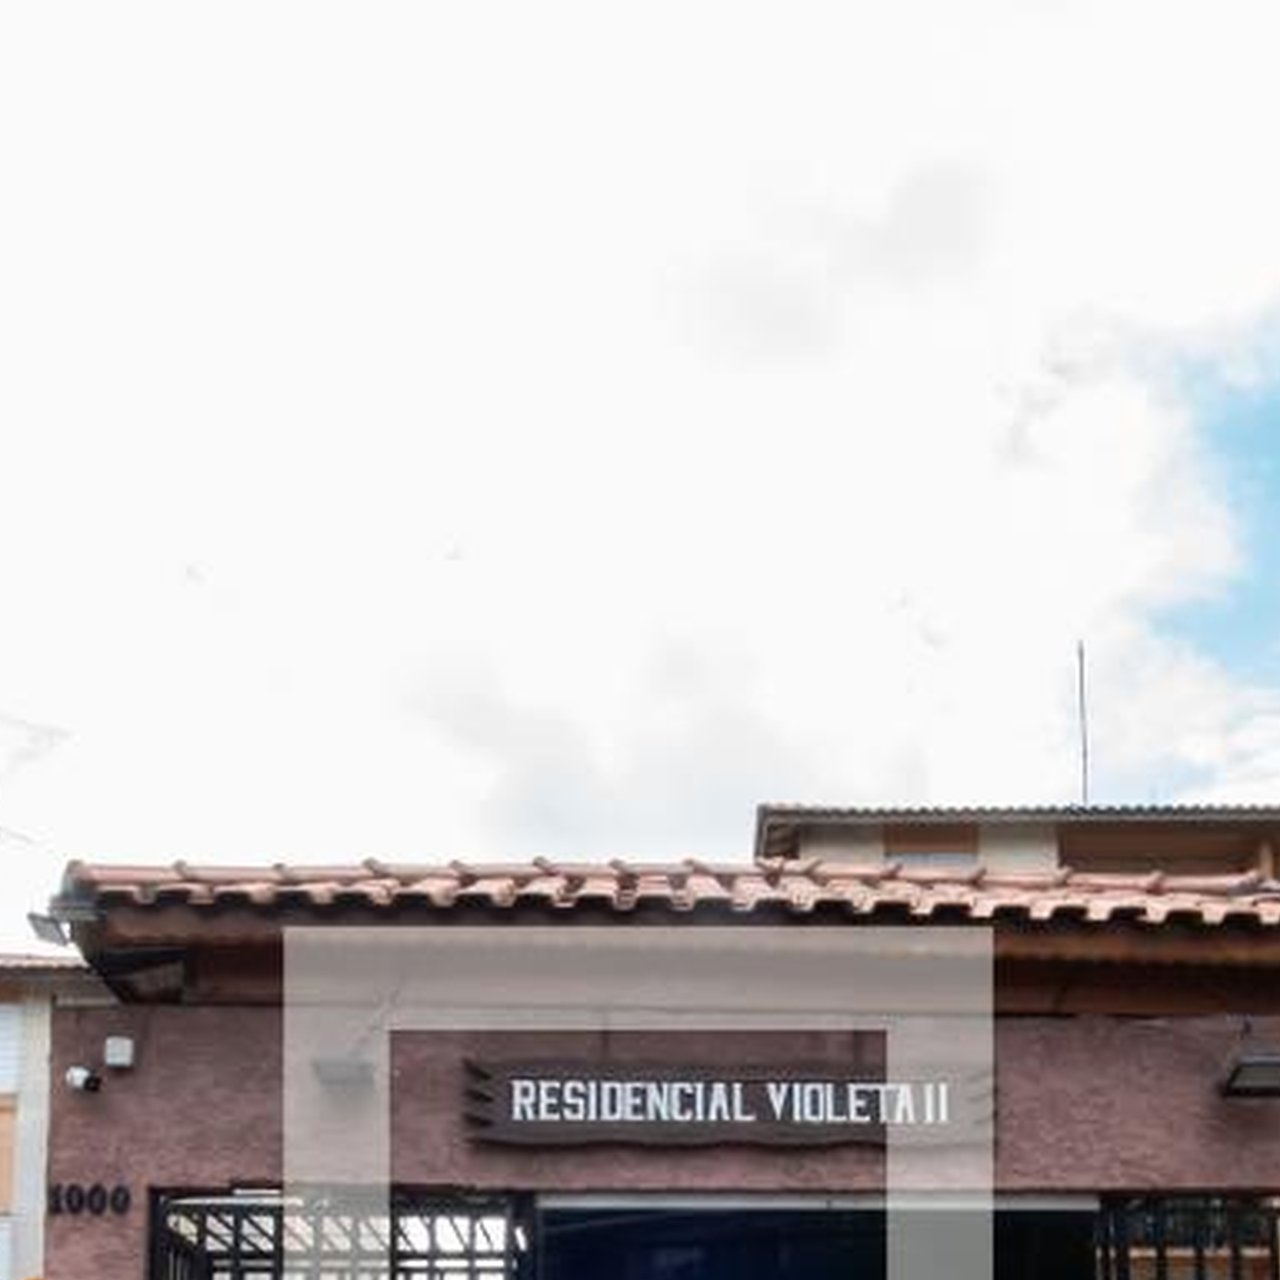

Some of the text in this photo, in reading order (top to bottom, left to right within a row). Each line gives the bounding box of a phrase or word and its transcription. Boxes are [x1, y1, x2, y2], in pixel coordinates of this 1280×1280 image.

[512, 1080, 949, 1122] RESIDENCIAL VIOLETA II
